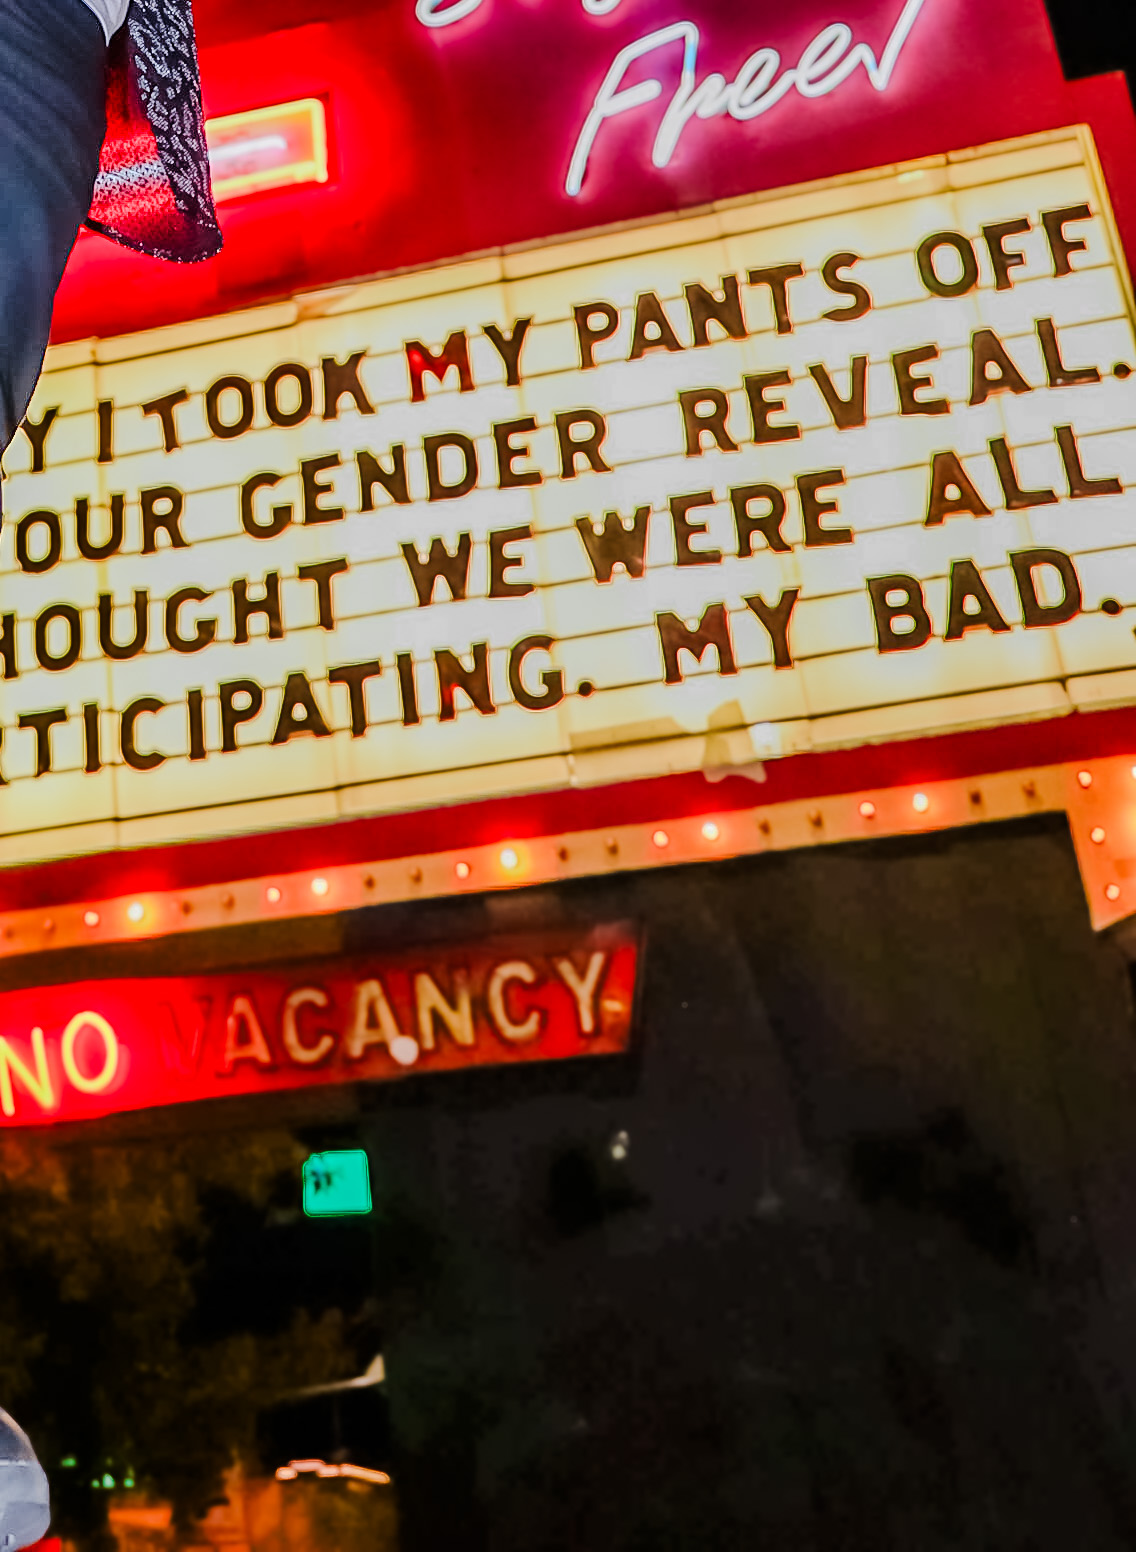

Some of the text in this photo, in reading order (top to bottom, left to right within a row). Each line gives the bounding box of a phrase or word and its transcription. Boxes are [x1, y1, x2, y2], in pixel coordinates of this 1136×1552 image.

[0, 202, 1093, 480] Y I TOOK MY PANTS OFF
[14, 316, 1132, 574] OUR GENDER REVEAL.
[401, 525, 537, 608] WE
[575, 468, 854, 584] WERE
[924, 424, 1123, 527] ALL
[655, 587, 802, 685] MY
[865, 548, 1123, 655] BAD.
[158, 950, 608, 1082] VACANCY
